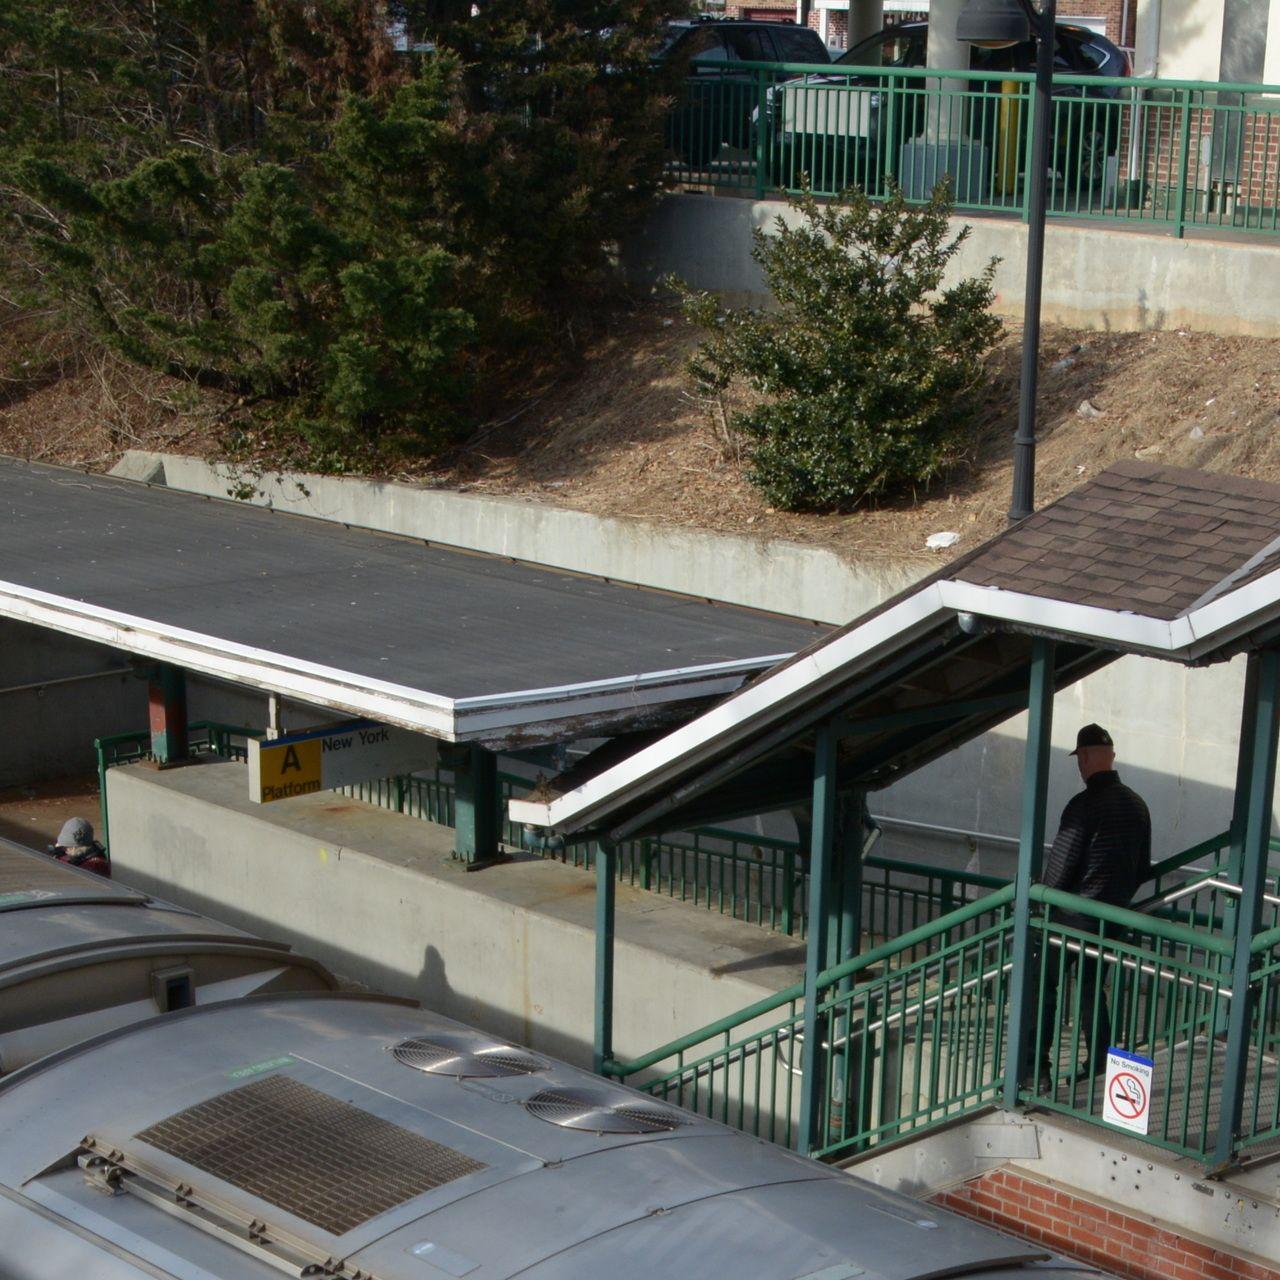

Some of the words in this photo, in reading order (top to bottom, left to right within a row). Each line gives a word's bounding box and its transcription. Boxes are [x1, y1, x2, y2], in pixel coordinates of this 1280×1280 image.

[322, 738, 352, 752] New
[359, 728, 389, 744] York
[280, 745, 301, 775] A
[261, 779, 320, 801] Platform
[1111, 1058, 1120, 1066] No
[1122, 1062, 1150, 1077] Smoking
